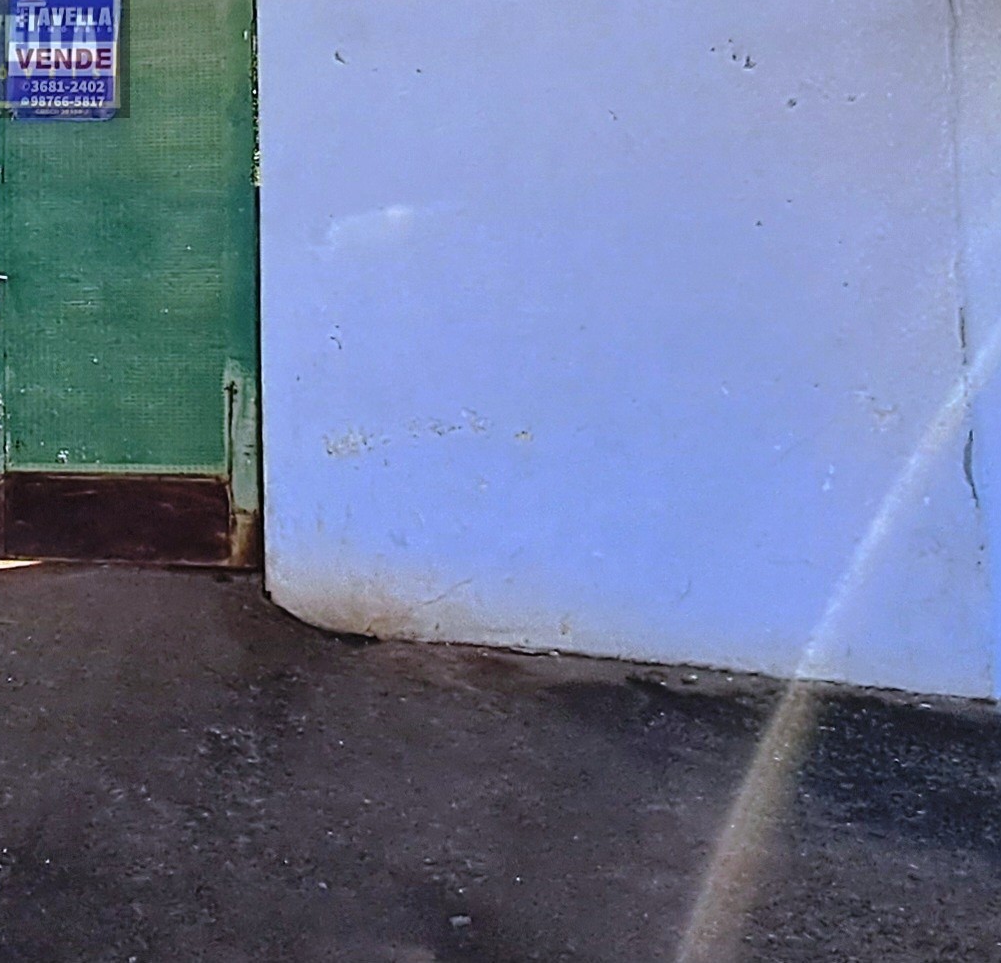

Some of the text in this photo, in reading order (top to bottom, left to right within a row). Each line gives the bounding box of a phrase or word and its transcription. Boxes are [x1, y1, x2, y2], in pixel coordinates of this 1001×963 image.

[17, 1, 111, 32] TAVELLA
[15, 48, 112, 69] VENDE
[30, 80, 105, 93] 3681-2402
[30, 96, 105, 107] 98766-5817
